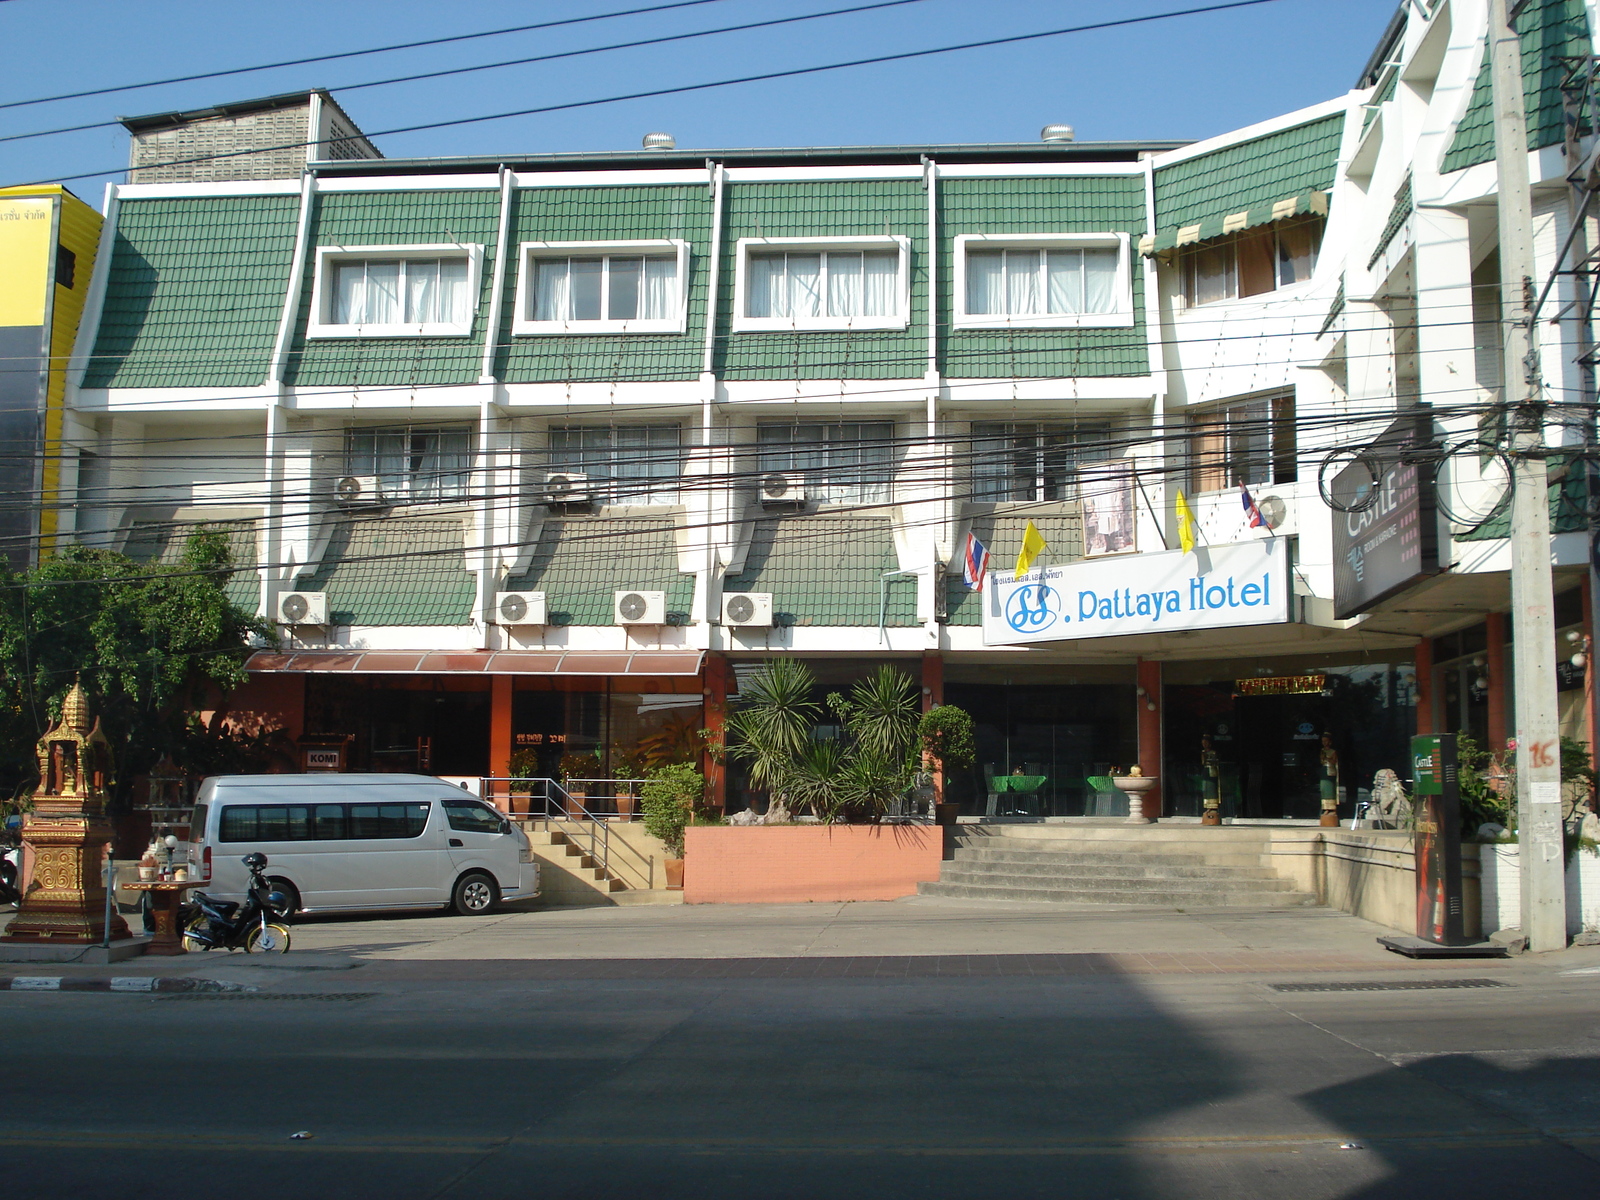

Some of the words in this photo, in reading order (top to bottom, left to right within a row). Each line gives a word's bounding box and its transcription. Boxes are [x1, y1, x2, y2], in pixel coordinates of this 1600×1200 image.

[23, 209, 46, 220] จำกัด
[1078, 587, 1181, 623] Pattaya
[1189, 572, 1270, 611] Hotel
[310, 754, 337, 763] KOMI
[1528, 739, 1558, 769] 16
